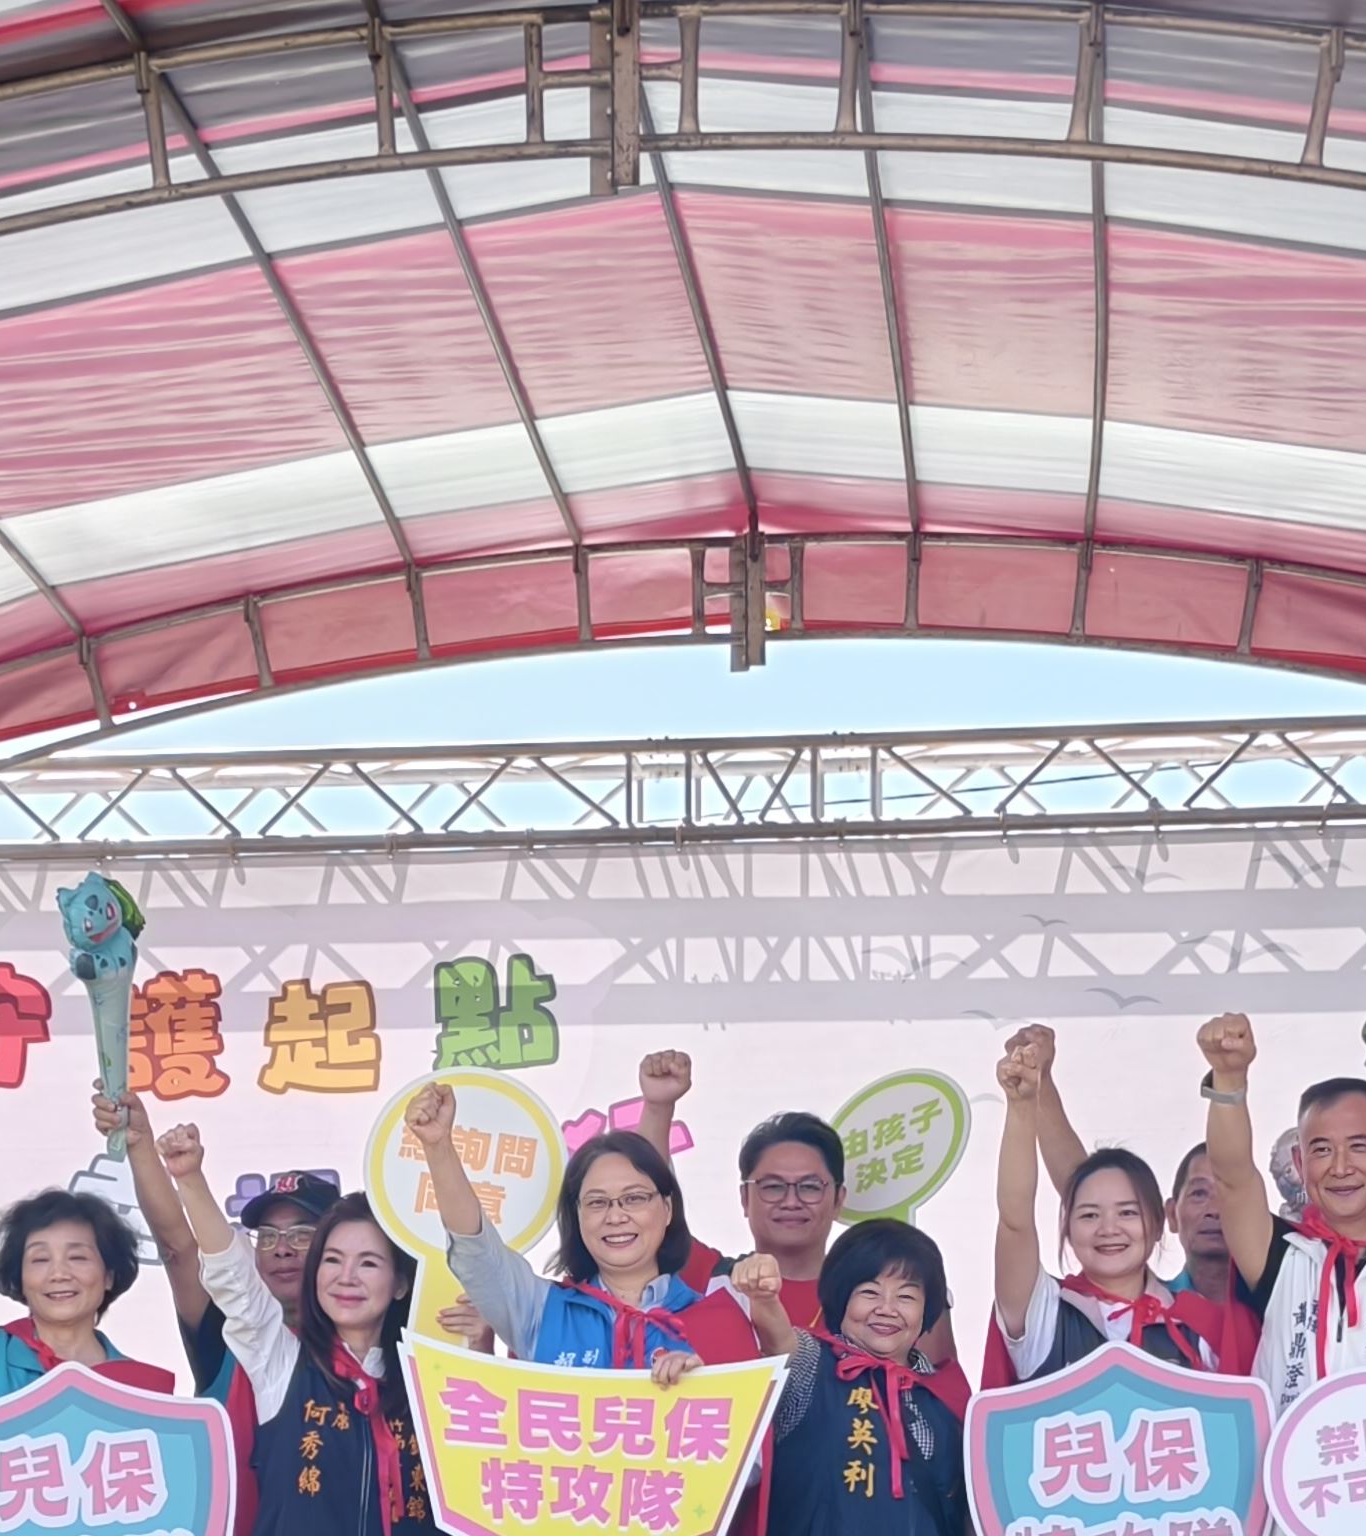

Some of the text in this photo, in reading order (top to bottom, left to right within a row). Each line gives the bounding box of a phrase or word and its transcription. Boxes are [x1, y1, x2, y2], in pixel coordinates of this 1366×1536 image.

[843, 1098, 943, 1160] 由孩子
[855, 1142, 925, 1194] 決定
[298, 1399, 332, 1498] 何秀綿
[438, 1378, 734, 1462] 全民兒保
[843, 1387, 880, 1499] 廖英利
[1041, 1418, 1200, 1496] 兒保
[481, 1458, 685, 1532] 特攻隊
